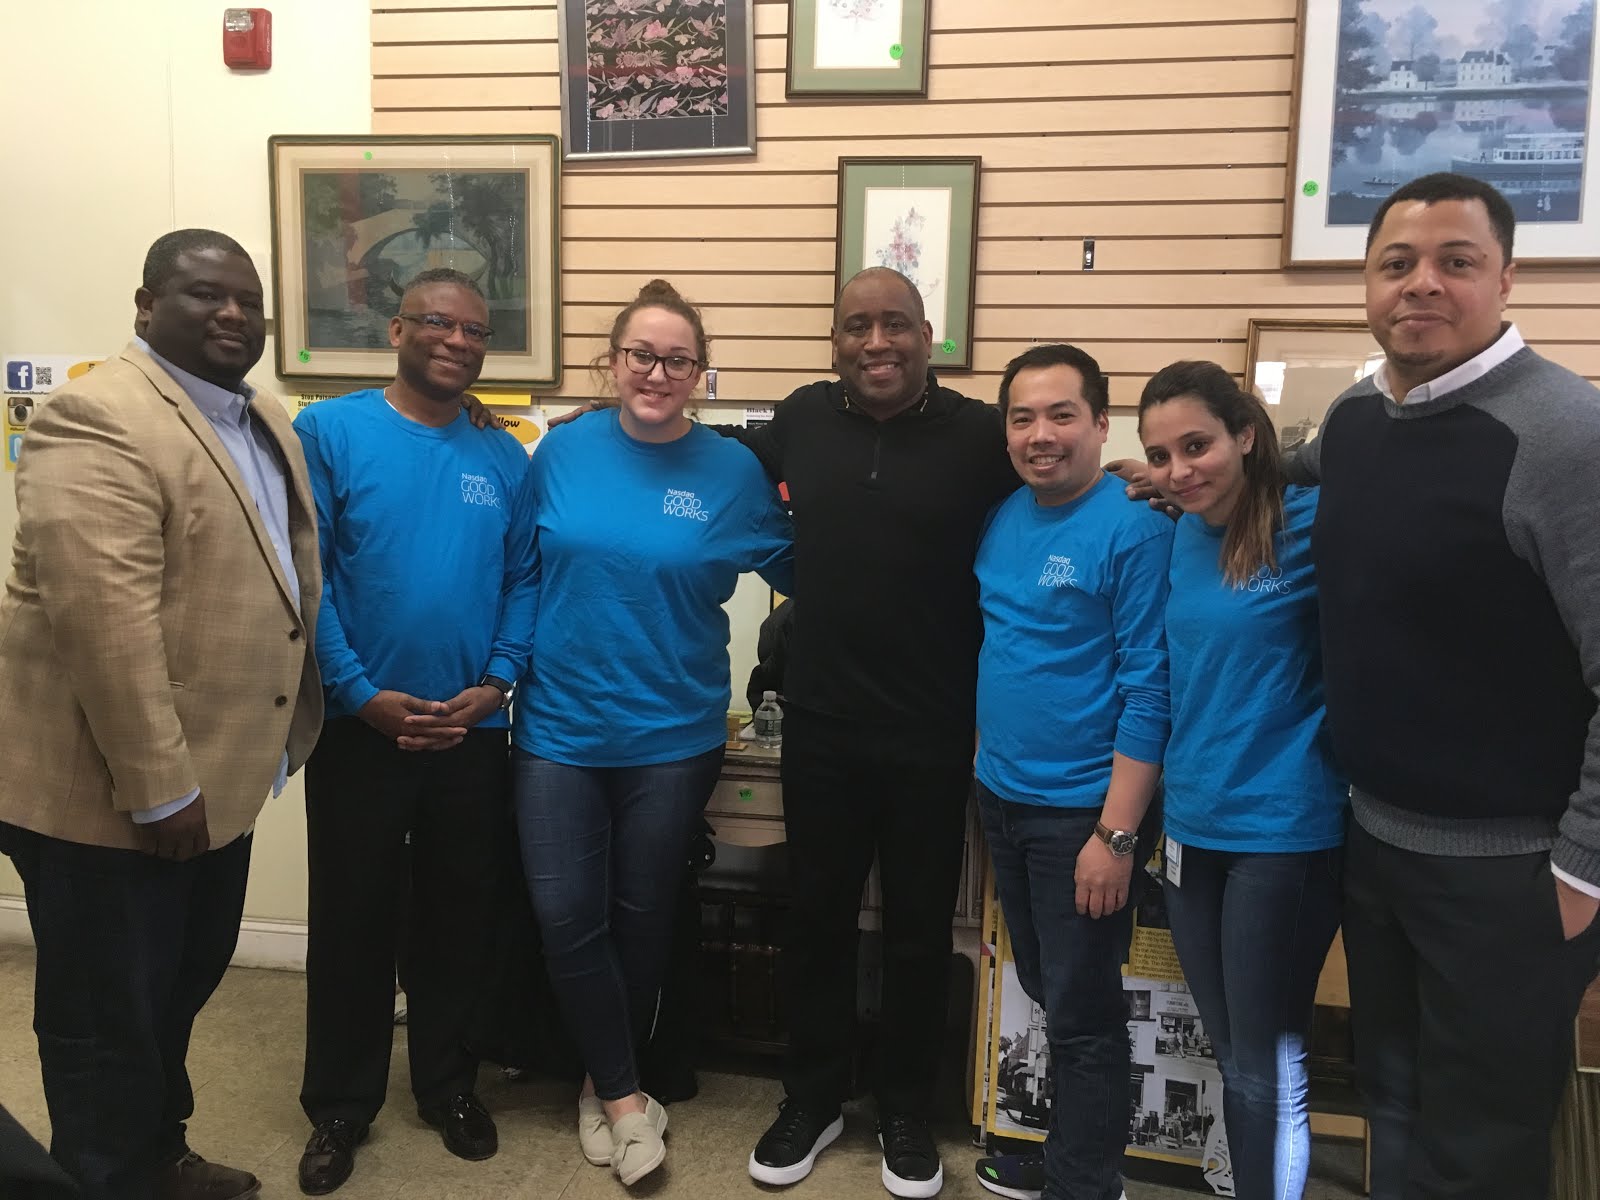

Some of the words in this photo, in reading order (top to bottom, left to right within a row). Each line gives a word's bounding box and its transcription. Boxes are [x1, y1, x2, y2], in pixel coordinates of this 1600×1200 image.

[461, 472, 488, 483] Nasdaq
[461, 480, 495, 496] GOOD
[667, 488, 695, 498] Nasdaq
[664, 494, 702, 510] GOOD
[664, 504, 709, 521] WORKS
[1048, 554, 1071, 565] Nasdaq
[1042, 562, 1075, 577] GOOD
[1250, 565, 1282, 579] OD
